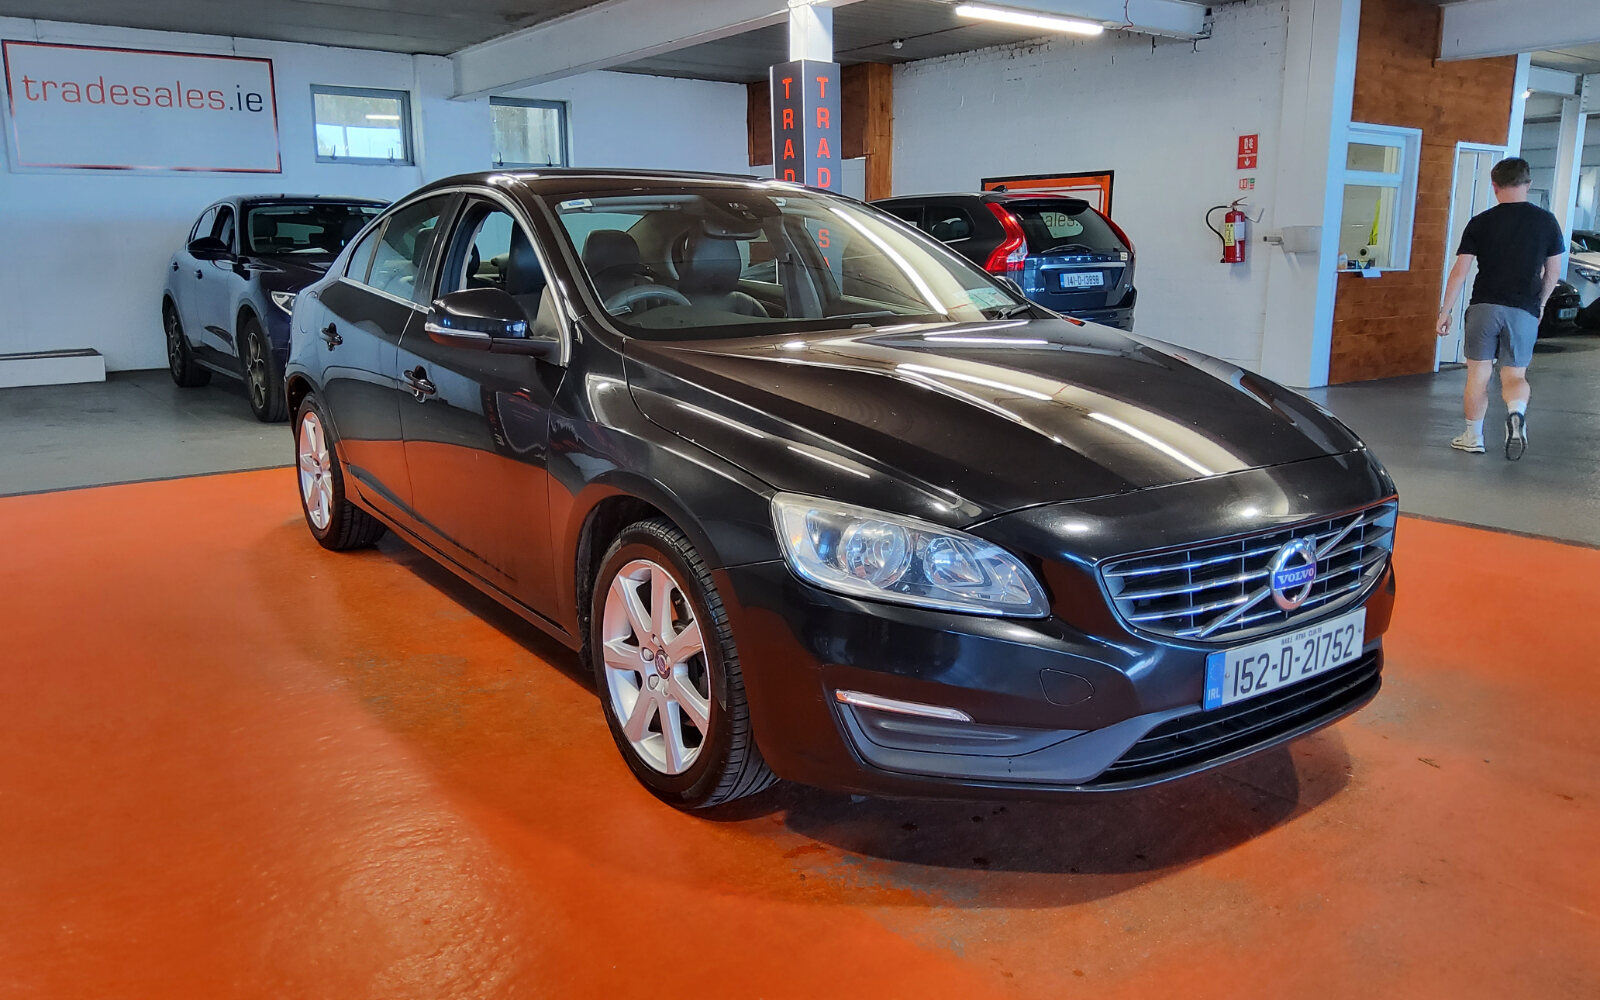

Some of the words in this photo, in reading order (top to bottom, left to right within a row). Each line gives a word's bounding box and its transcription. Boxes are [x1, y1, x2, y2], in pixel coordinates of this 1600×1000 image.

[21, 74, 264, 113] tradesales.ie
[1277, 568, 1315, 585] VOLVO
[1232, 623, 1355, 698] 152-D-21752
[1207, 688, 1221, 701] IRL
